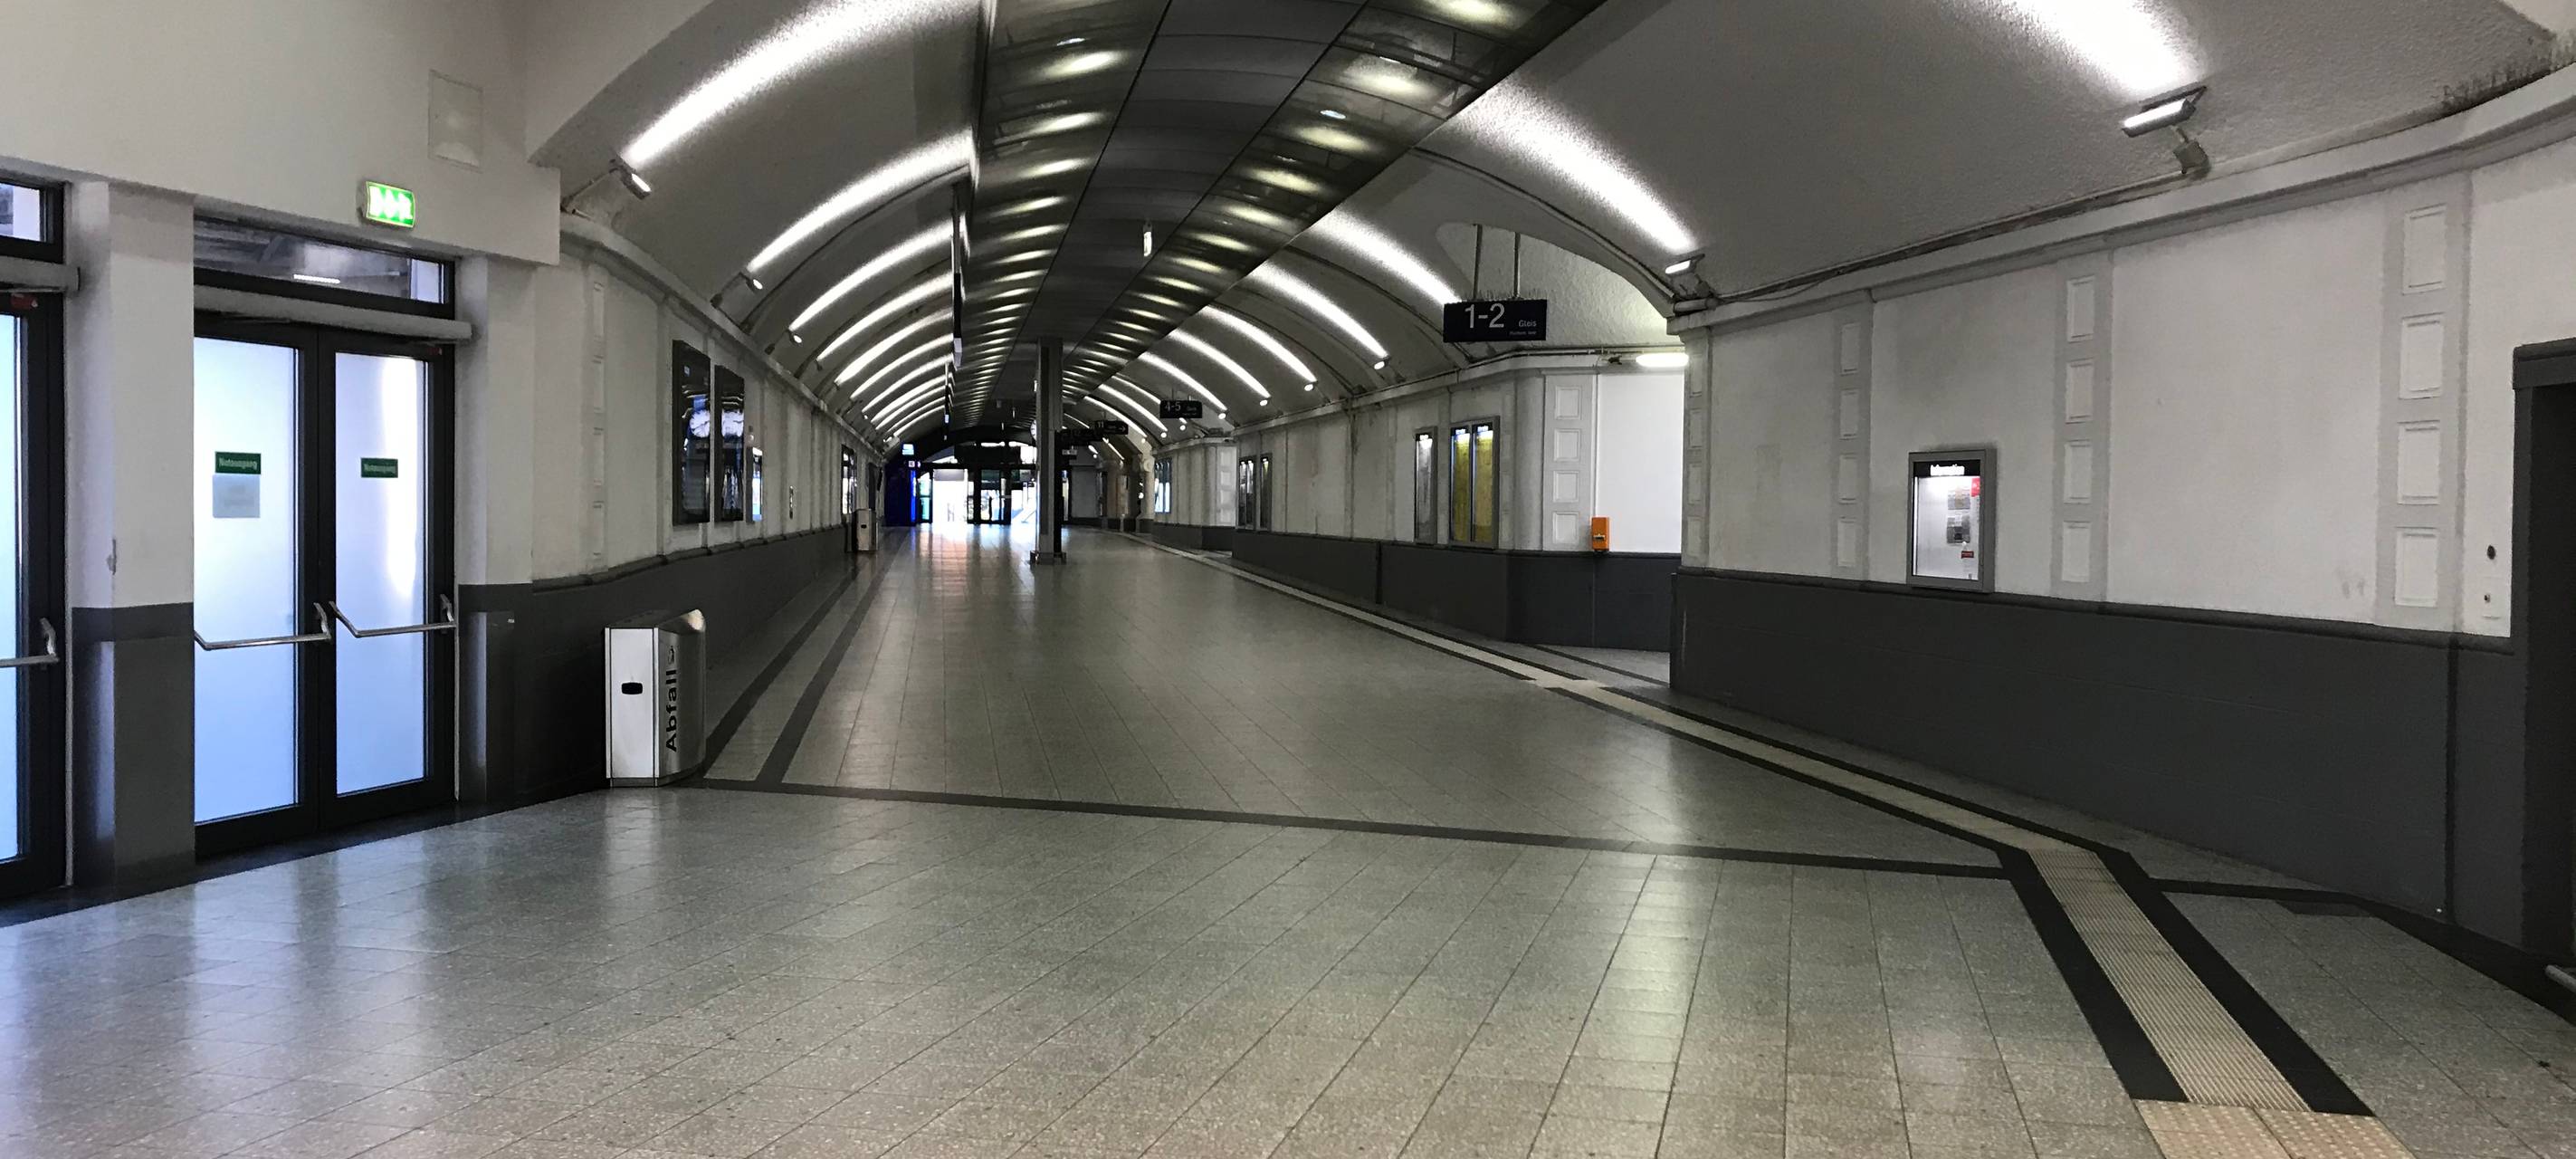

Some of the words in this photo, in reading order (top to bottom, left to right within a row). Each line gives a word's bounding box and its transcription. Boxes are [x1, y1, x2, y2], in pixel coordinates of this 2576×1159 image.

[1465, 302, 1505, 329] 1-2
[1518, 320, 1537, 328] Gleis
[665, 669, 678, 752] Abfall
